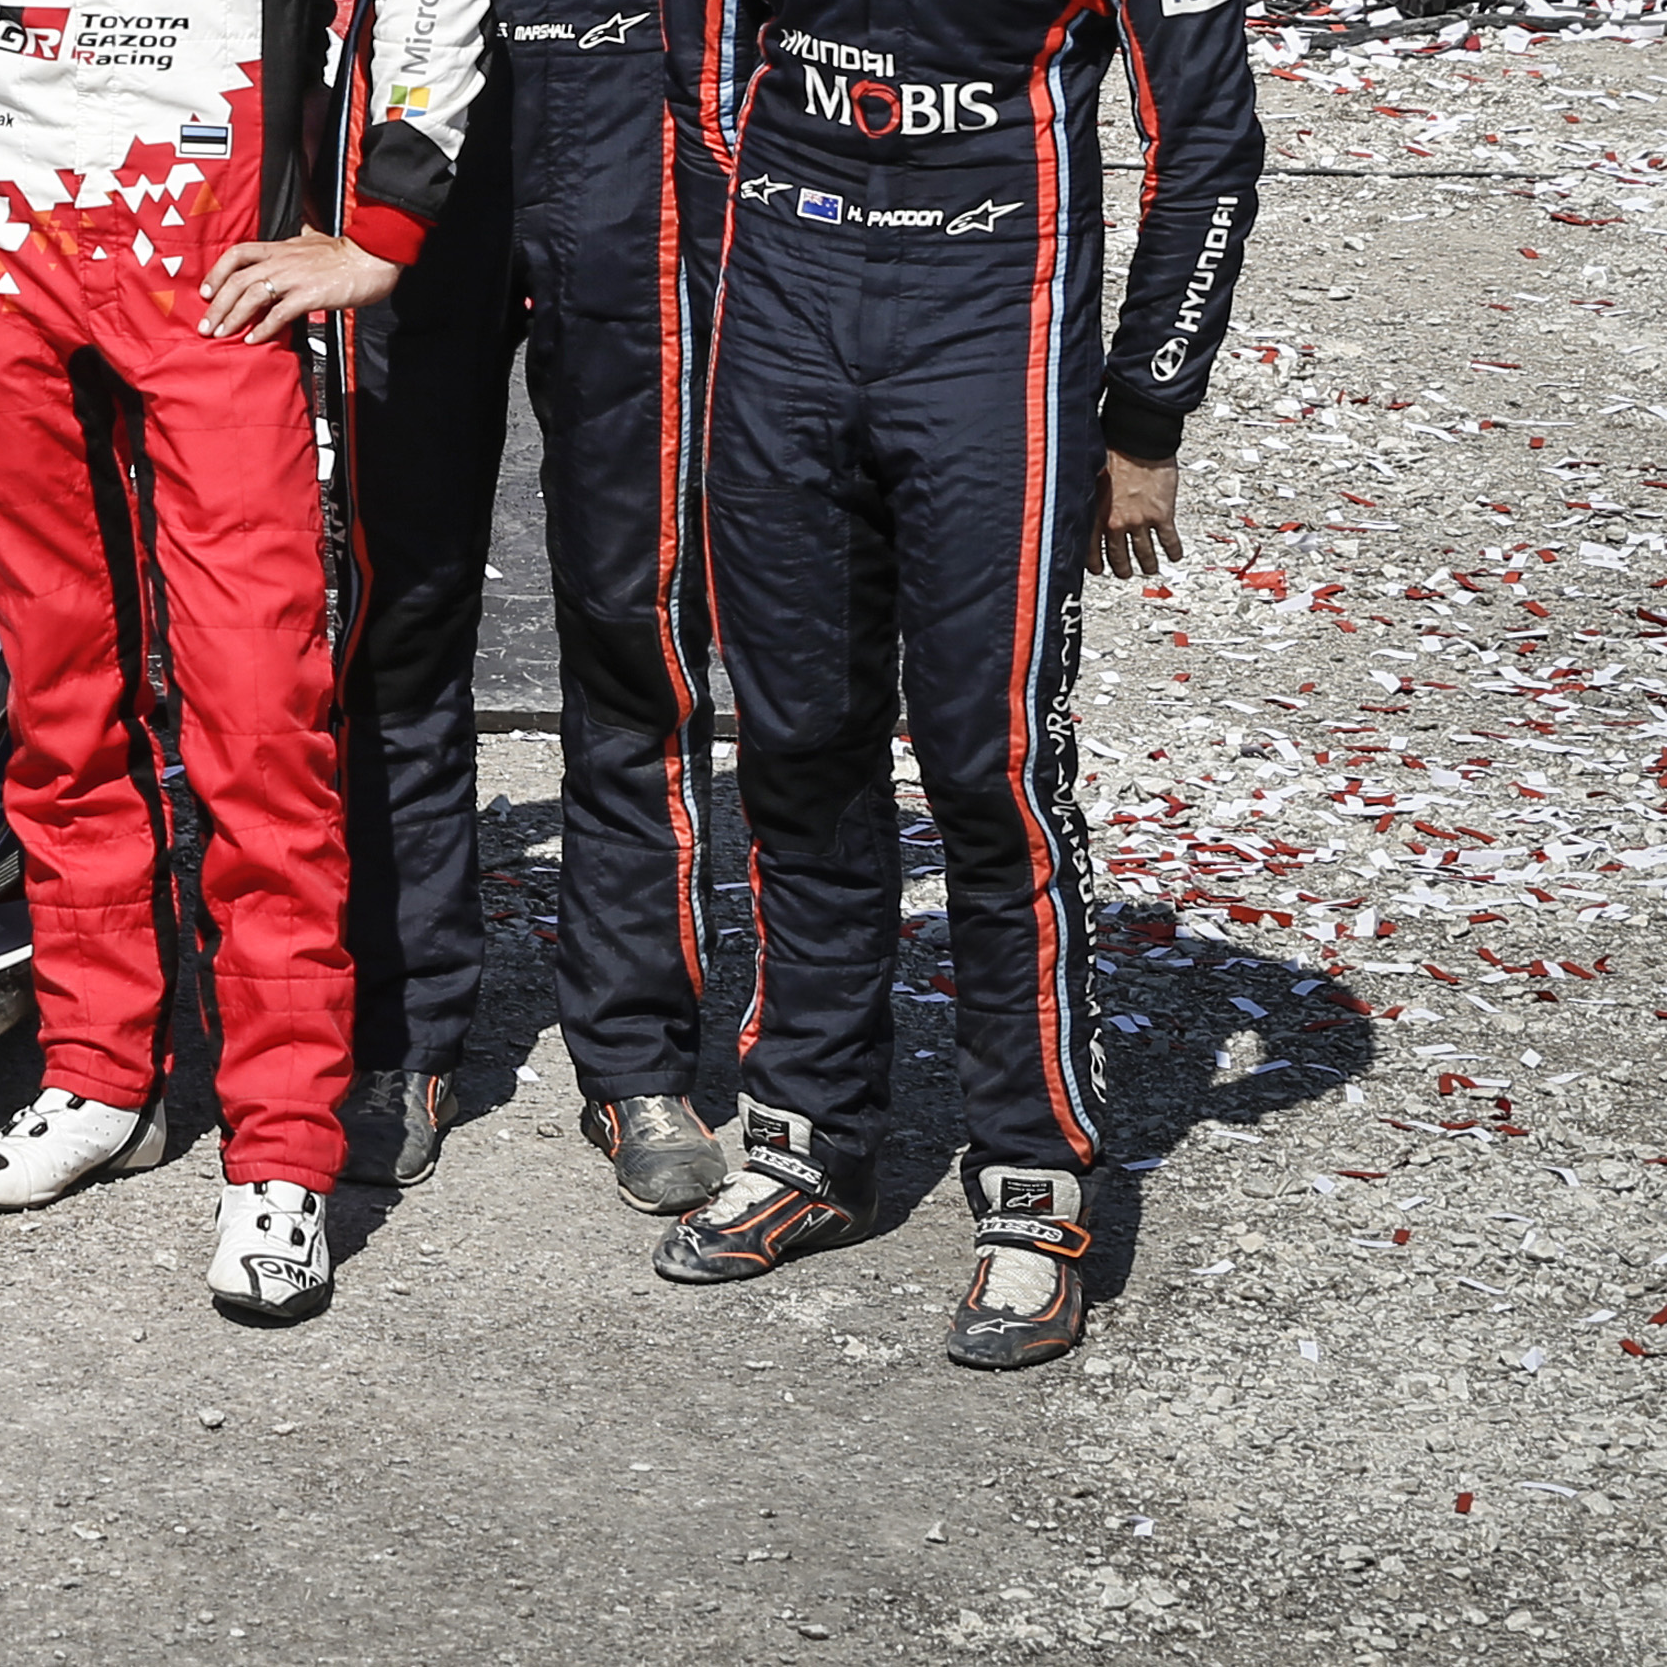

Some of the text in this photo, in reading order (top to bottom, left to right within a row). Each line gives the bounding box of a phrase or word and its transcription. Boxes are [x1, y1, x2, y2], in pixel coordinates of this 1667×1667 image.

[80, 13, 190, 30] TOYOTA
[514, 23, 576, 41] MARSHALL
[76, 32, 178, 49] GAZOO
[71, 50, 174, 71] Racing
[779, 28, 895, 78] HYUNDAI
[801, 64, 1000, 139] MOBIS
[846, 204, 944, 228] H. PADDON
[1173, 195, 1239, 334] HYUNDAI
